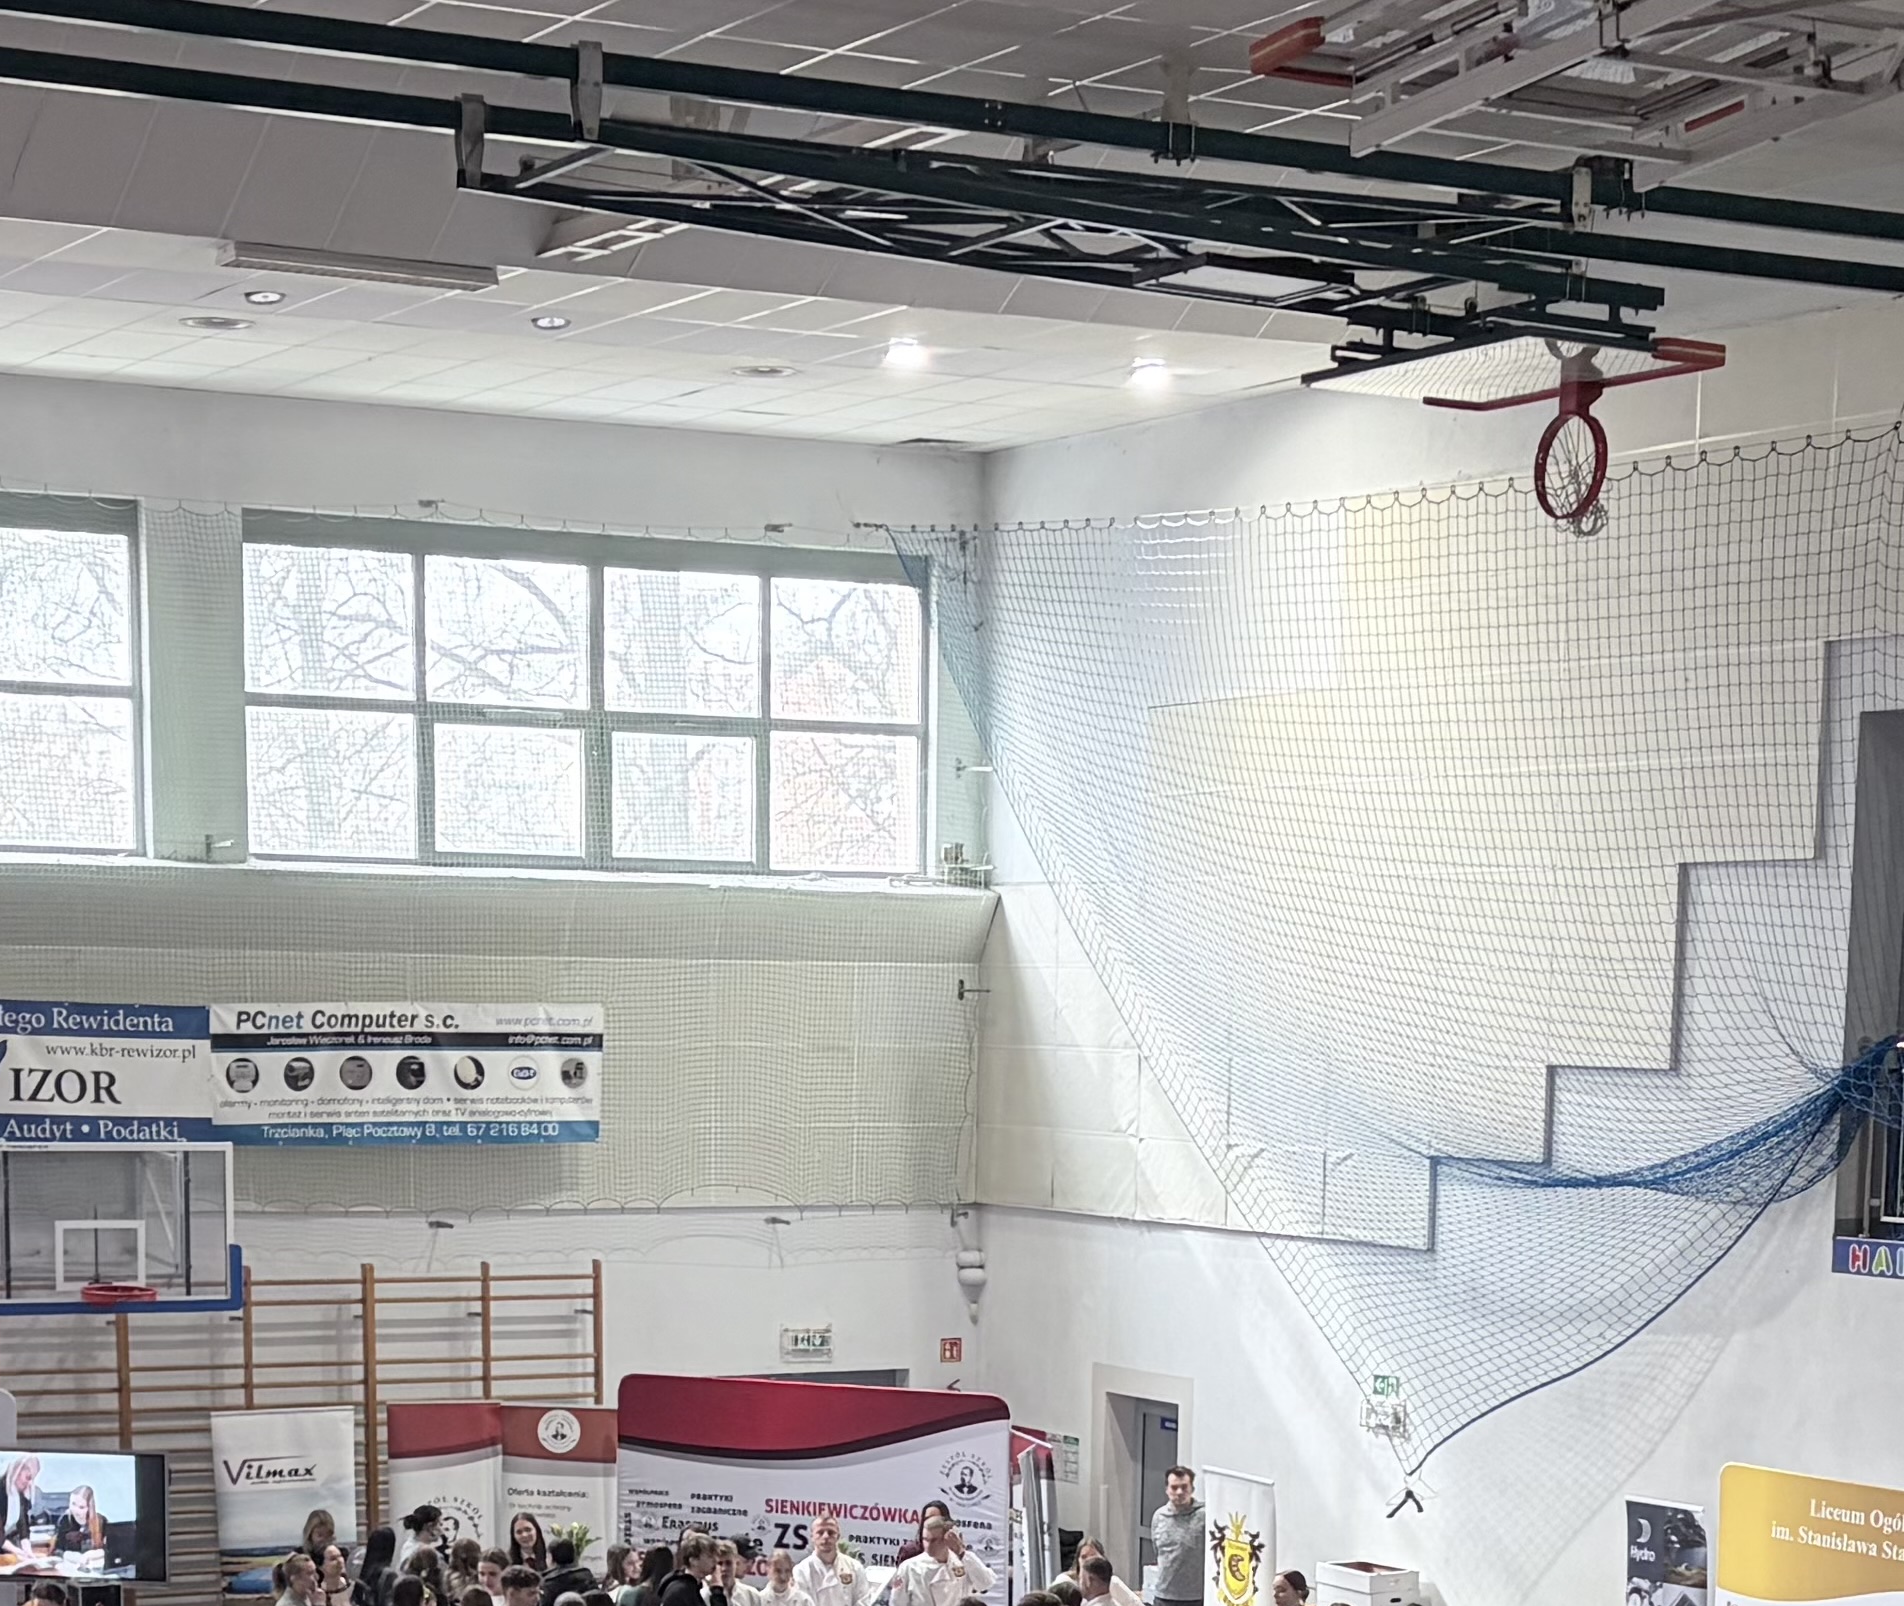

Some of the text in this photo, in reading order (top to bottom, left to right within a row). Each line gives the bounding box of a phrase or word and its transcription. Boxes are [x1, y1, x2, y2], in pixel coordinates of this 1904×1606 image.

[53, 1008, 174, 1032] Rewidenta
[236, 1010, 459, 1033] PCnet Computer s.c.
[45, 1042, 196, 1061] www.kbr-rewizor.pl
[3, 1119, 73, 1142] Audyt
[99, 1121, 180, 1141] Podatki
[333, 1124, 361, 1138] Plac
[364, 1124, 422, 1140] Pocztowy
[223, 1456, 317, 1485] Vilmax
[764, 1498, 920, 1524] SIENKIEWICZÓWKA
[1809, 1499, 1865, 1526] Liceum
[774, 1523, 809, 1550] ZS
[1770, 1522, 1794, 1542] im.
[1798, 1526, 1878, 1558] Stanisława
[1630, 1545, 1656, 1562] Hydro
